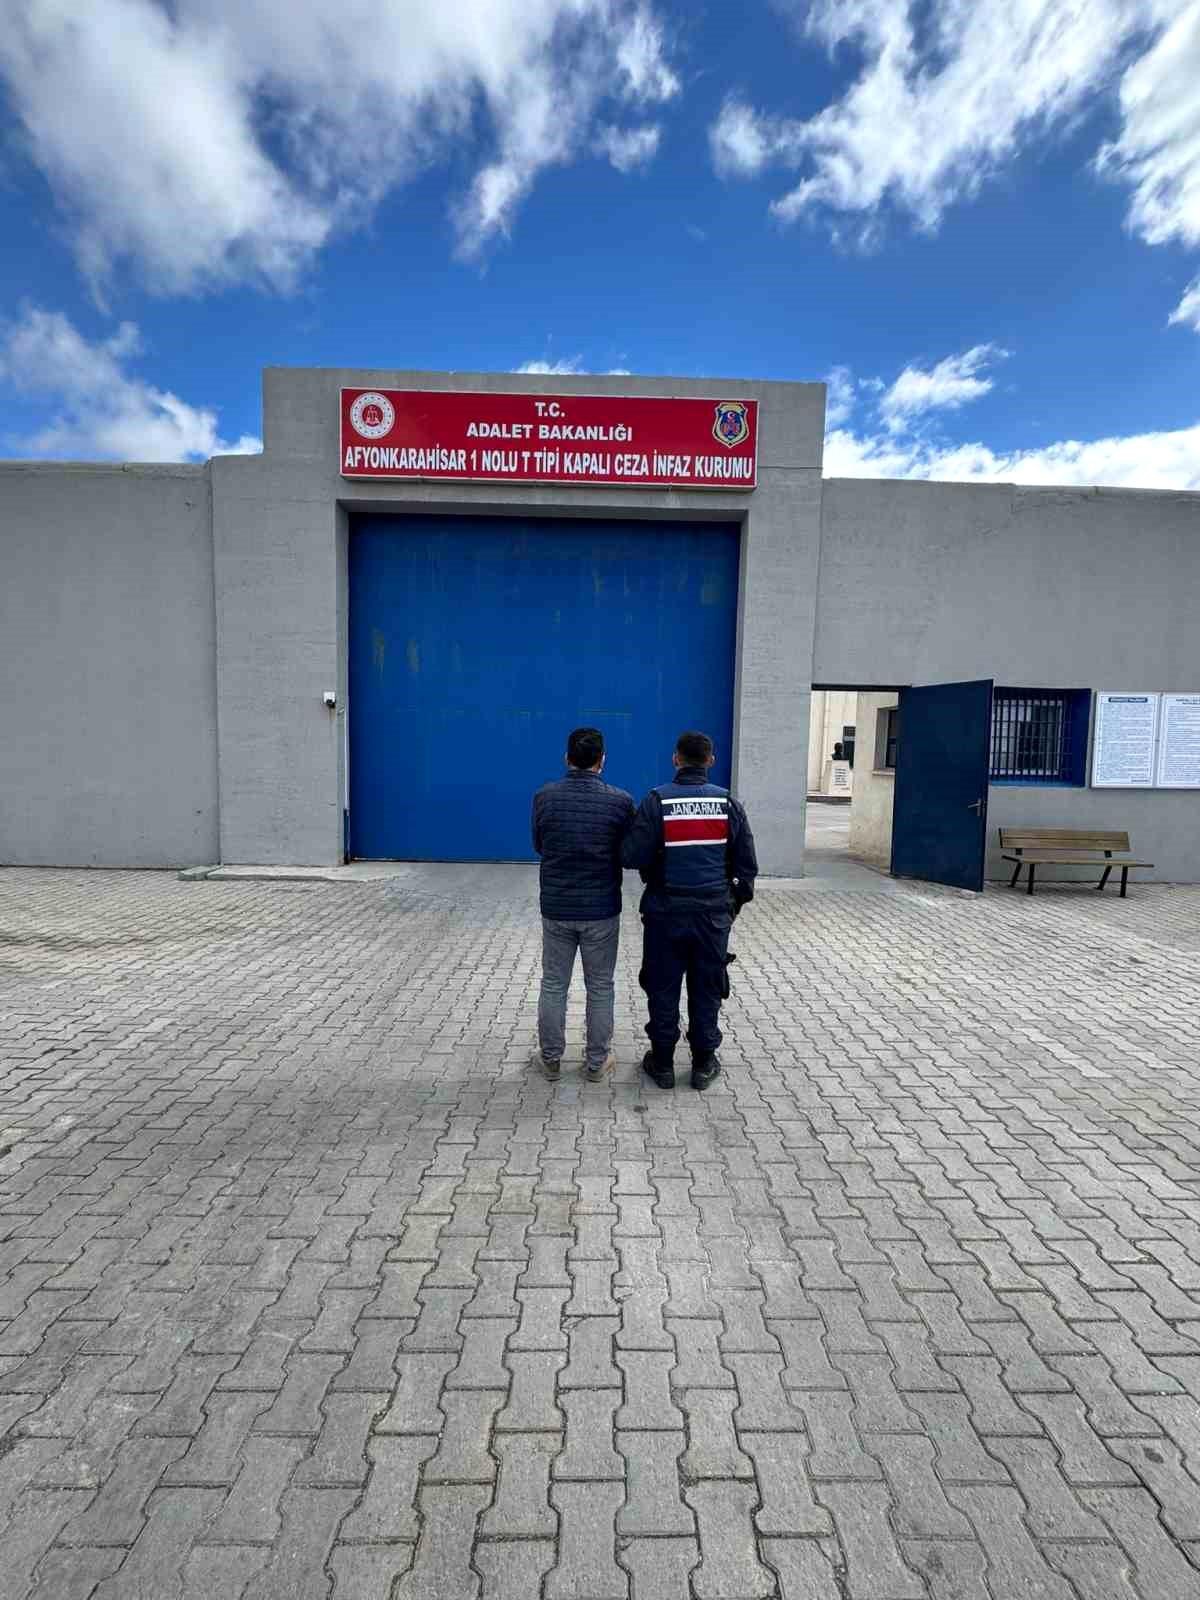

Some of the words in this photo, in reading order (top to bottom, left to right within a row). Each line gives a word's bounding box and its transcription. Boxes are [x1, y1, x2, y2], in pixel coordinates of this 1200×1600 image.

[535, 402, 566, 418] T.C.
[466, 423, 532, 439] ADALET
[539, 423, 633, 442] BAKANLIĞI
[344, 443, 467, 470] AFYONKARAHİSAR
[470, 451, 477, 470] 1
[482, 452, 516, 472] NOLU
[521, 452, 530, 472] T
[534, 446, 560, 473] TİPİ
[564, 453, 610, 475] KAPALI
[614, 454, 649, 477] CEZA
[653, 449, 691, 477] İNFAZ
[694, 456, 753, 479] KURUMU
[670, 802, 723, 816] JANDARMA
